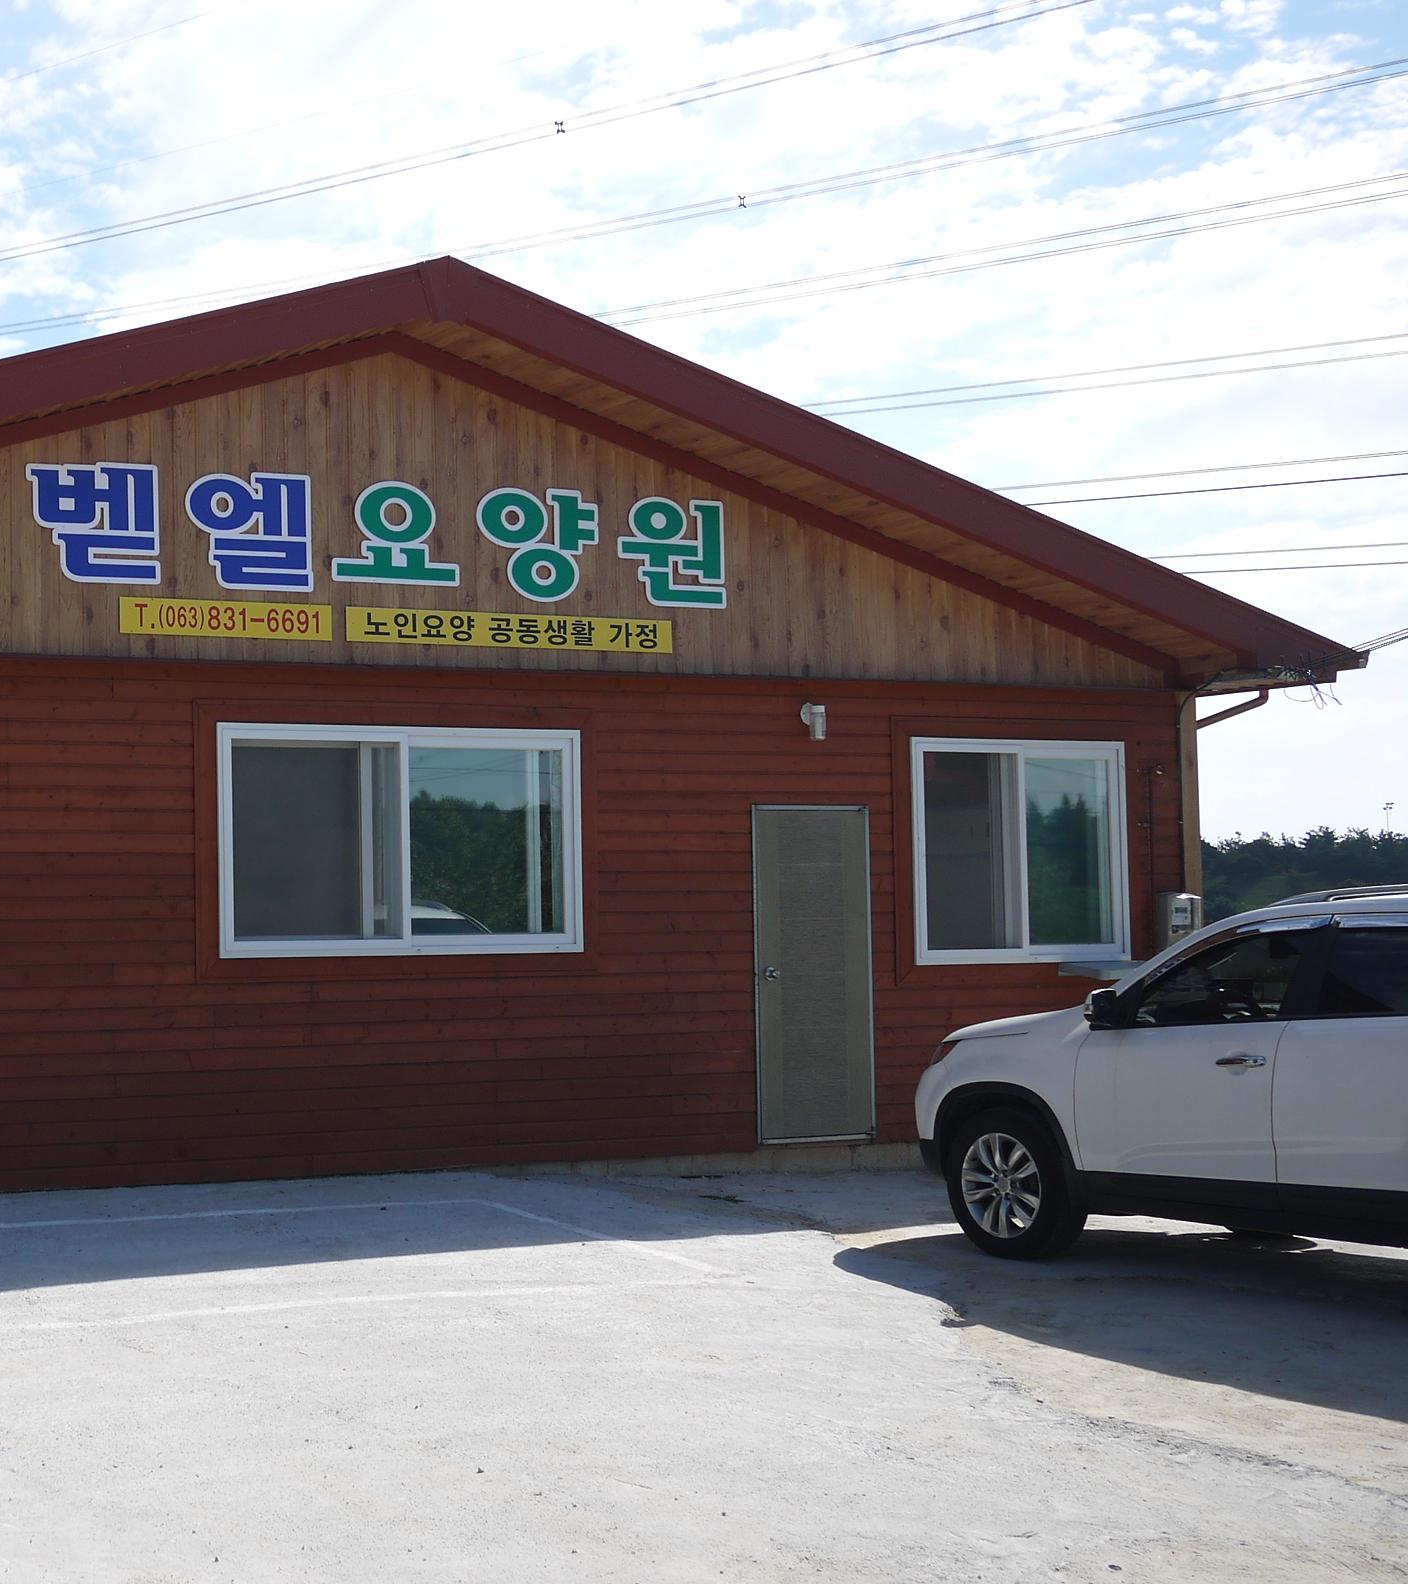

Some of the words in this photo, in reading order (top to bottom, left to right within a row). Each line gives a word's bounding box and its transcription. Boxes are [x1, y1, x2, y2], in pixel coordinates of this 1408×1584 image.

[363, 612, 476, 642] 노인요양
[487, 616, 596, 646] 공동생활
[608, 620, 660, 649] 가정
